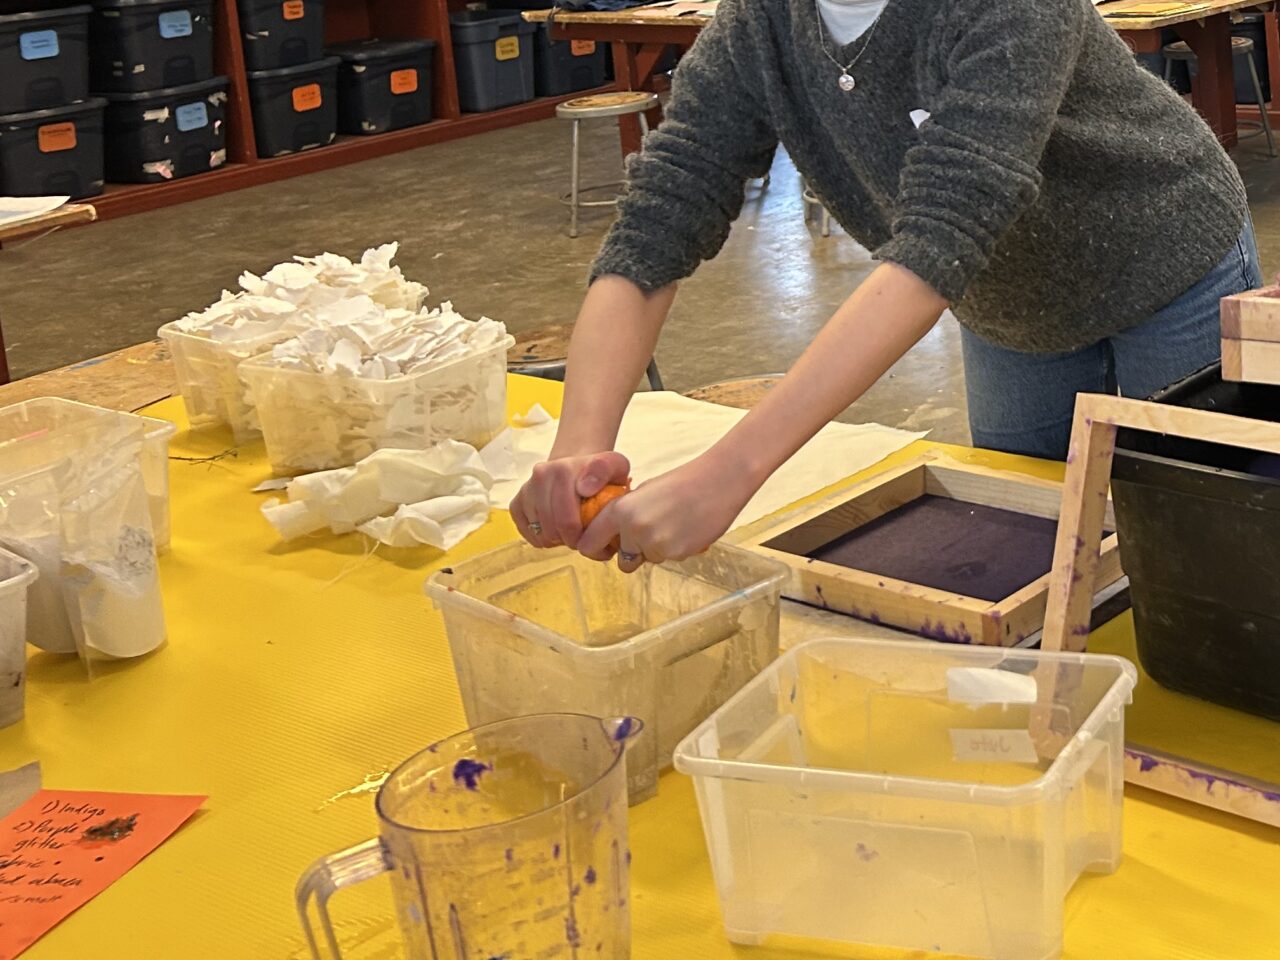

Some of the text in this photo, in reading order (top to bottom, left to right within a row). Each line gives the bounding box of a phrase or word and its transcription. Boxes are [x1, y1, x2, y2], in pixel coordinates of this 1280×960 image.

[58, 802, 107, 823] Indigo
[32, 818, 79, 838] Purple
[11, 836, 66, 853] glitter
